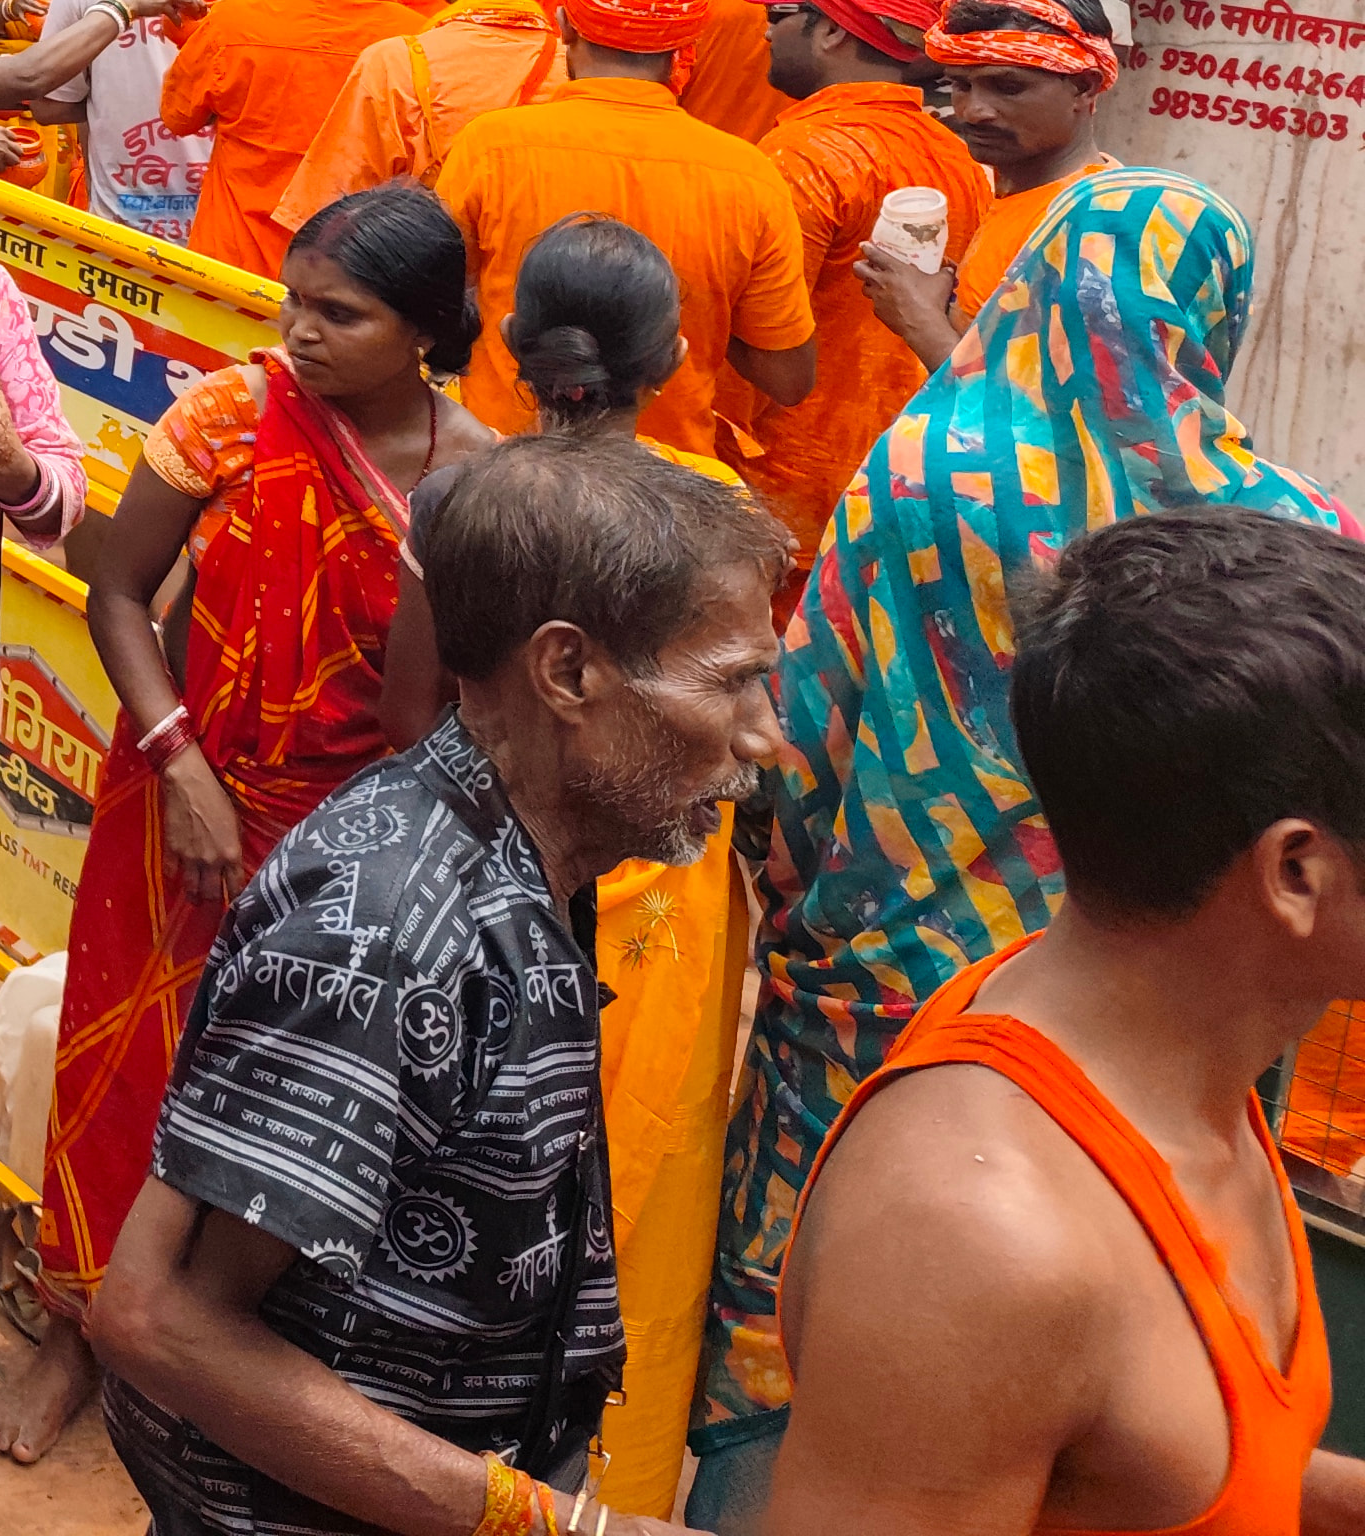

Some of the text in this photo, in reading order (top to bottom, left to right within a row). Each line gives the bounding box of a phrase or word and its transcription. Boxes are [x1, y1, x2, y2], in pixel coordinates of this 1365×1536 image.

[1159, 48, 1365, 107] 9304464264
[1148, 87, 1349, 141] 9835536303
[111, 154, 178, 189] रवि
[77, 259, 164, 316] दुमका
[21, 845, 51, 881] TMT
[251, 1067, 335, 1109] जय महाकाल
[240, 1108, 318, 1149] जय महाकाल
[574, 1324, 597, 1339] जय
